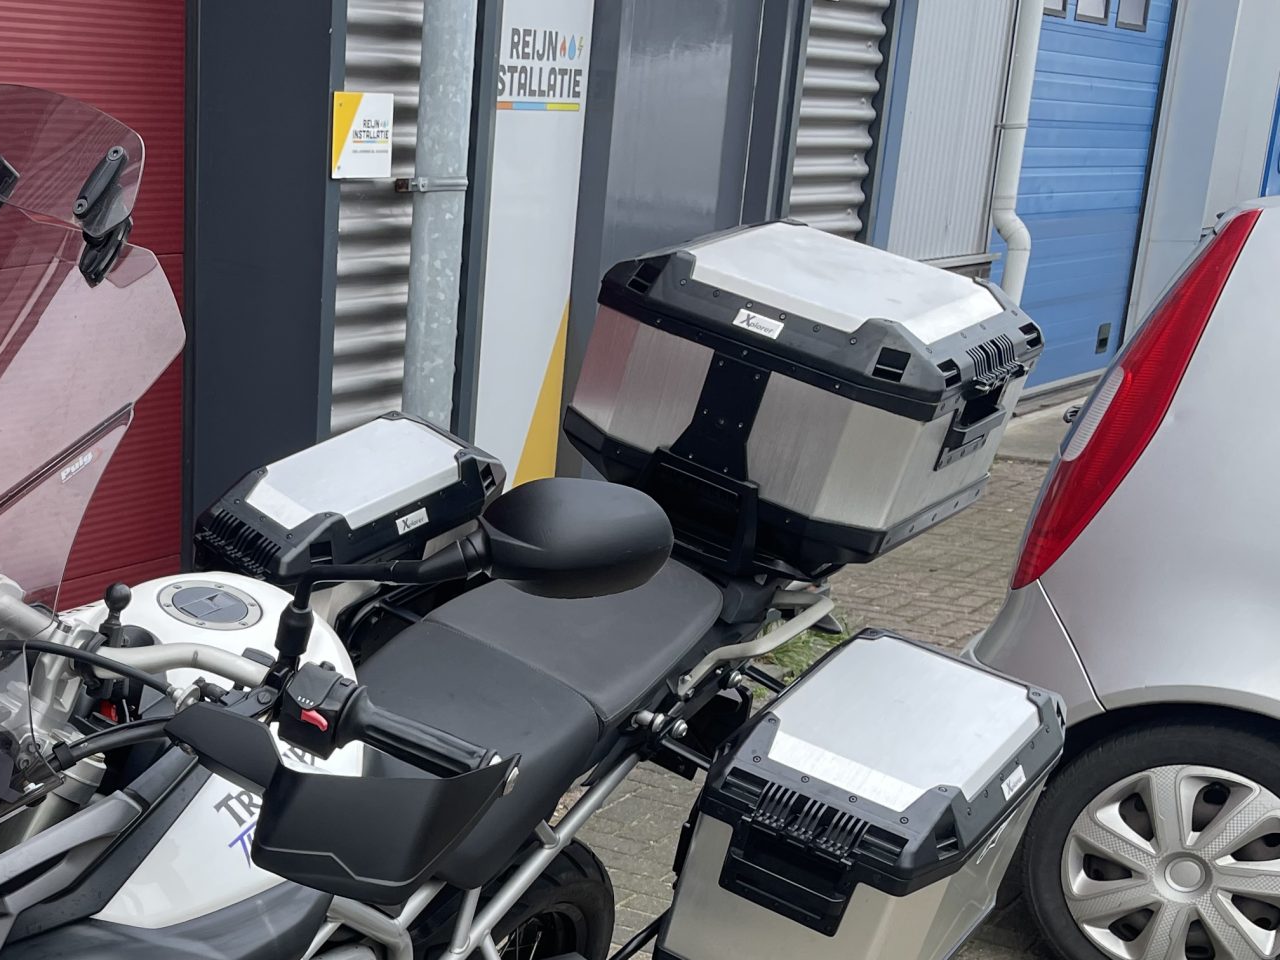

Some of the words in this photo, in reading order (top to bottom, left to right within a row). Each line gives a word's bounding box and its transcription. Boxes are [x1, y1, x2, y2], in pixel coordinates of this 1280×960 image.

[510, 28, 558, 61] REIJN
[497, 64, 582, 98] STALLATIE
[363, 119, 380, 128] REIJN
[352, 130, 389, 139] INSTALLATIE
